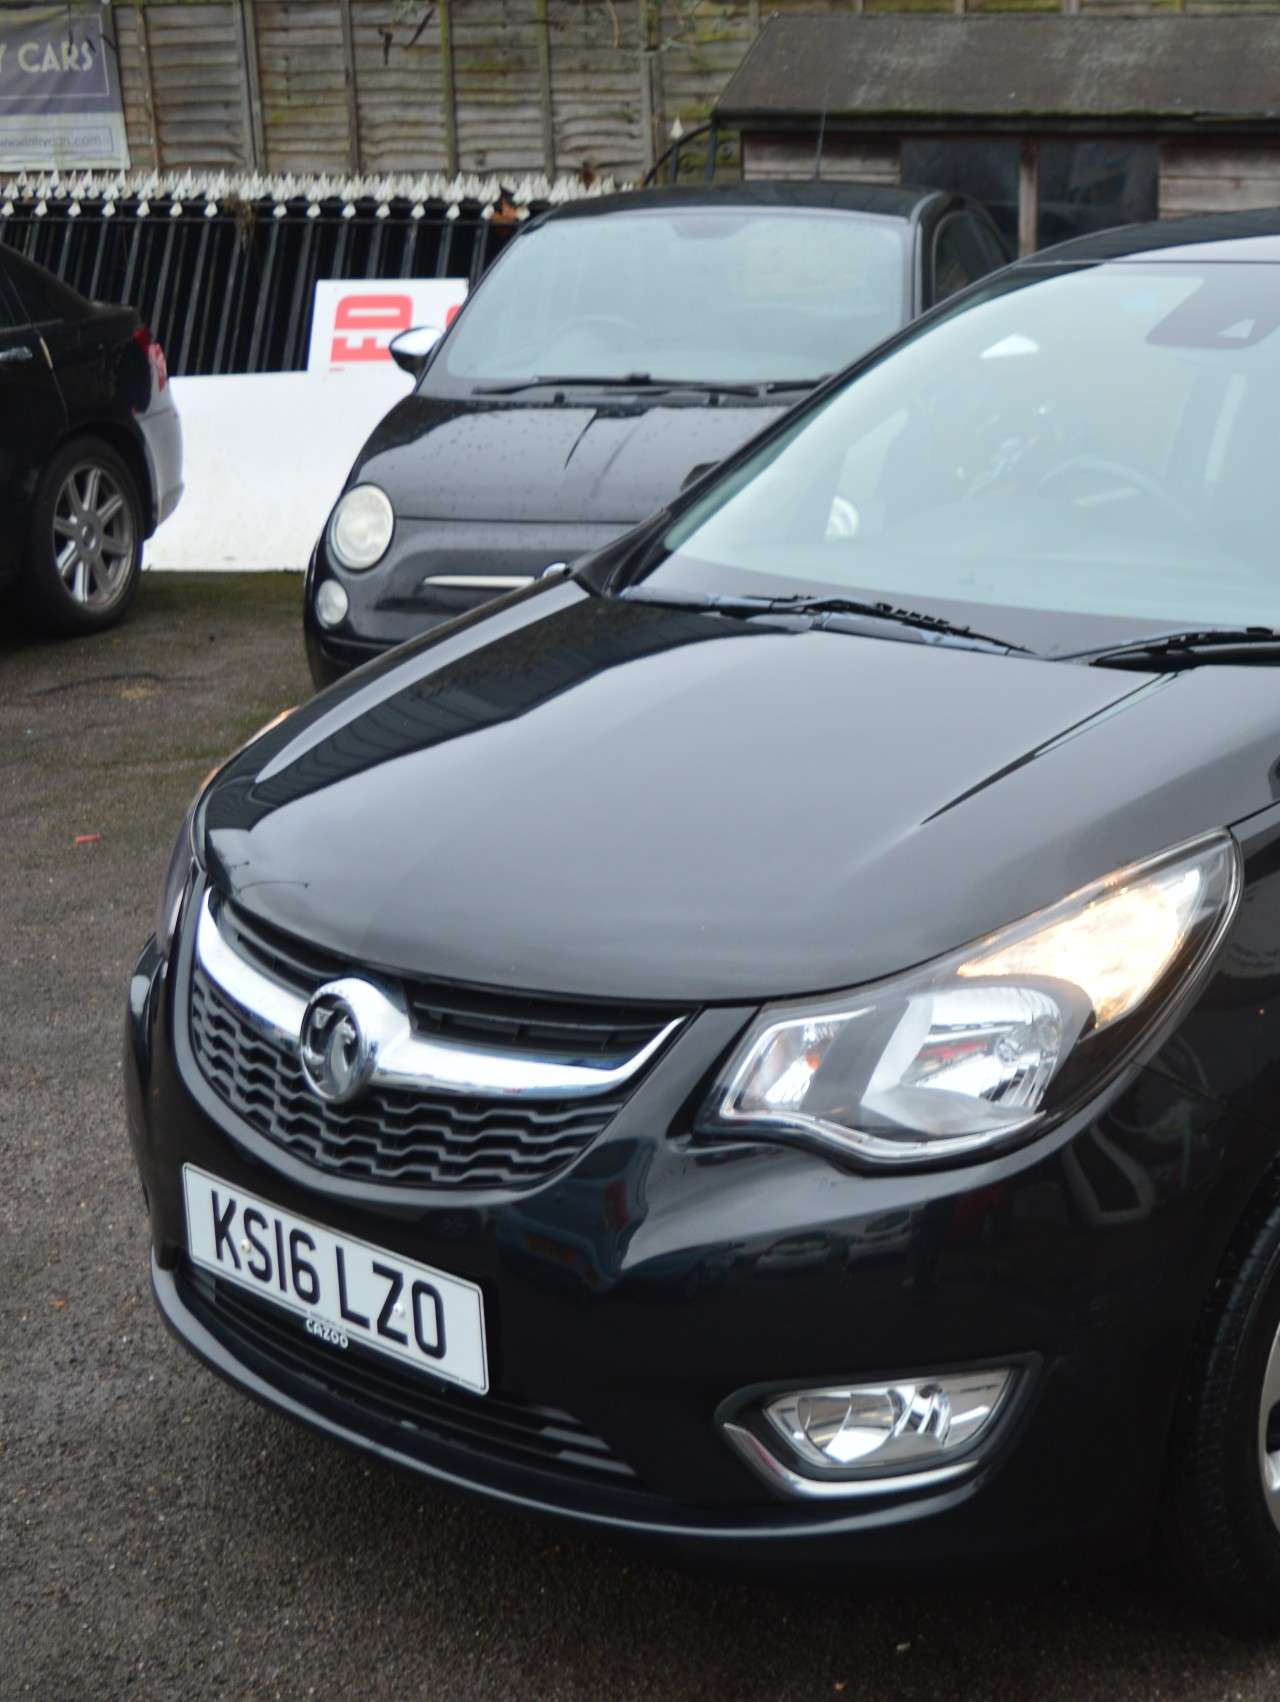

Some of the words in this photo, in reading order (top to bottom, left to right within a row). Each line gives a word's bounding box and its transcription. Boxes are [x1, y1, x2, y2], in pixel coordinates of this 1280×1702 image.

[18, 40, 94, 73] CARS
[211, 1190, 321, 1305] KS16
[335, 1245, 447, 1360] LZO
